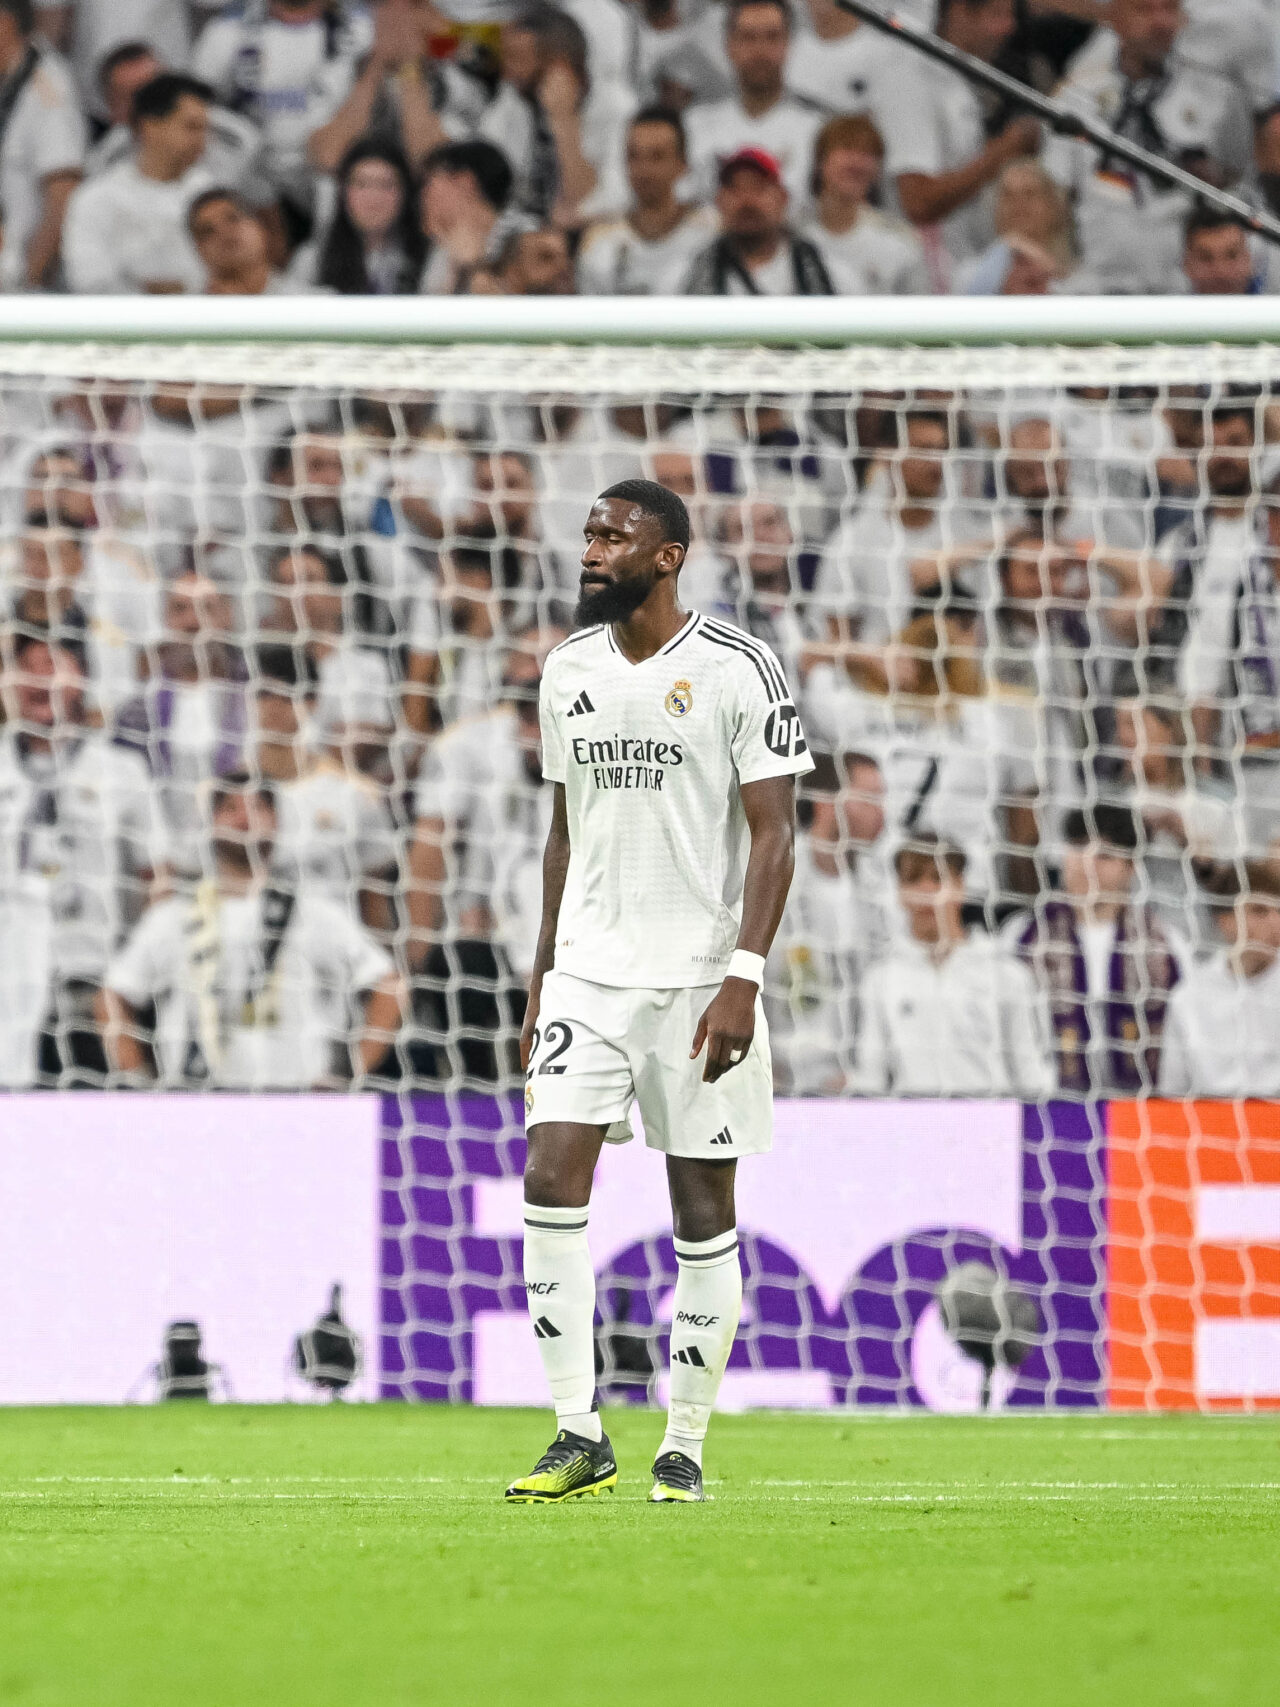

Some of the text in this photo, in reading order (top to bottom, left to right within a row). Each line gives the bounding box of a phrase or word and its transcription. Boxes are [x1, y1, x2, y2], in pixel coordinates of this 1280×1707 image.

[770, 705, 808, 757] hp
[571, 733, 683, 766] Emirates
[677, 1310, 720, 1328] RMCF
